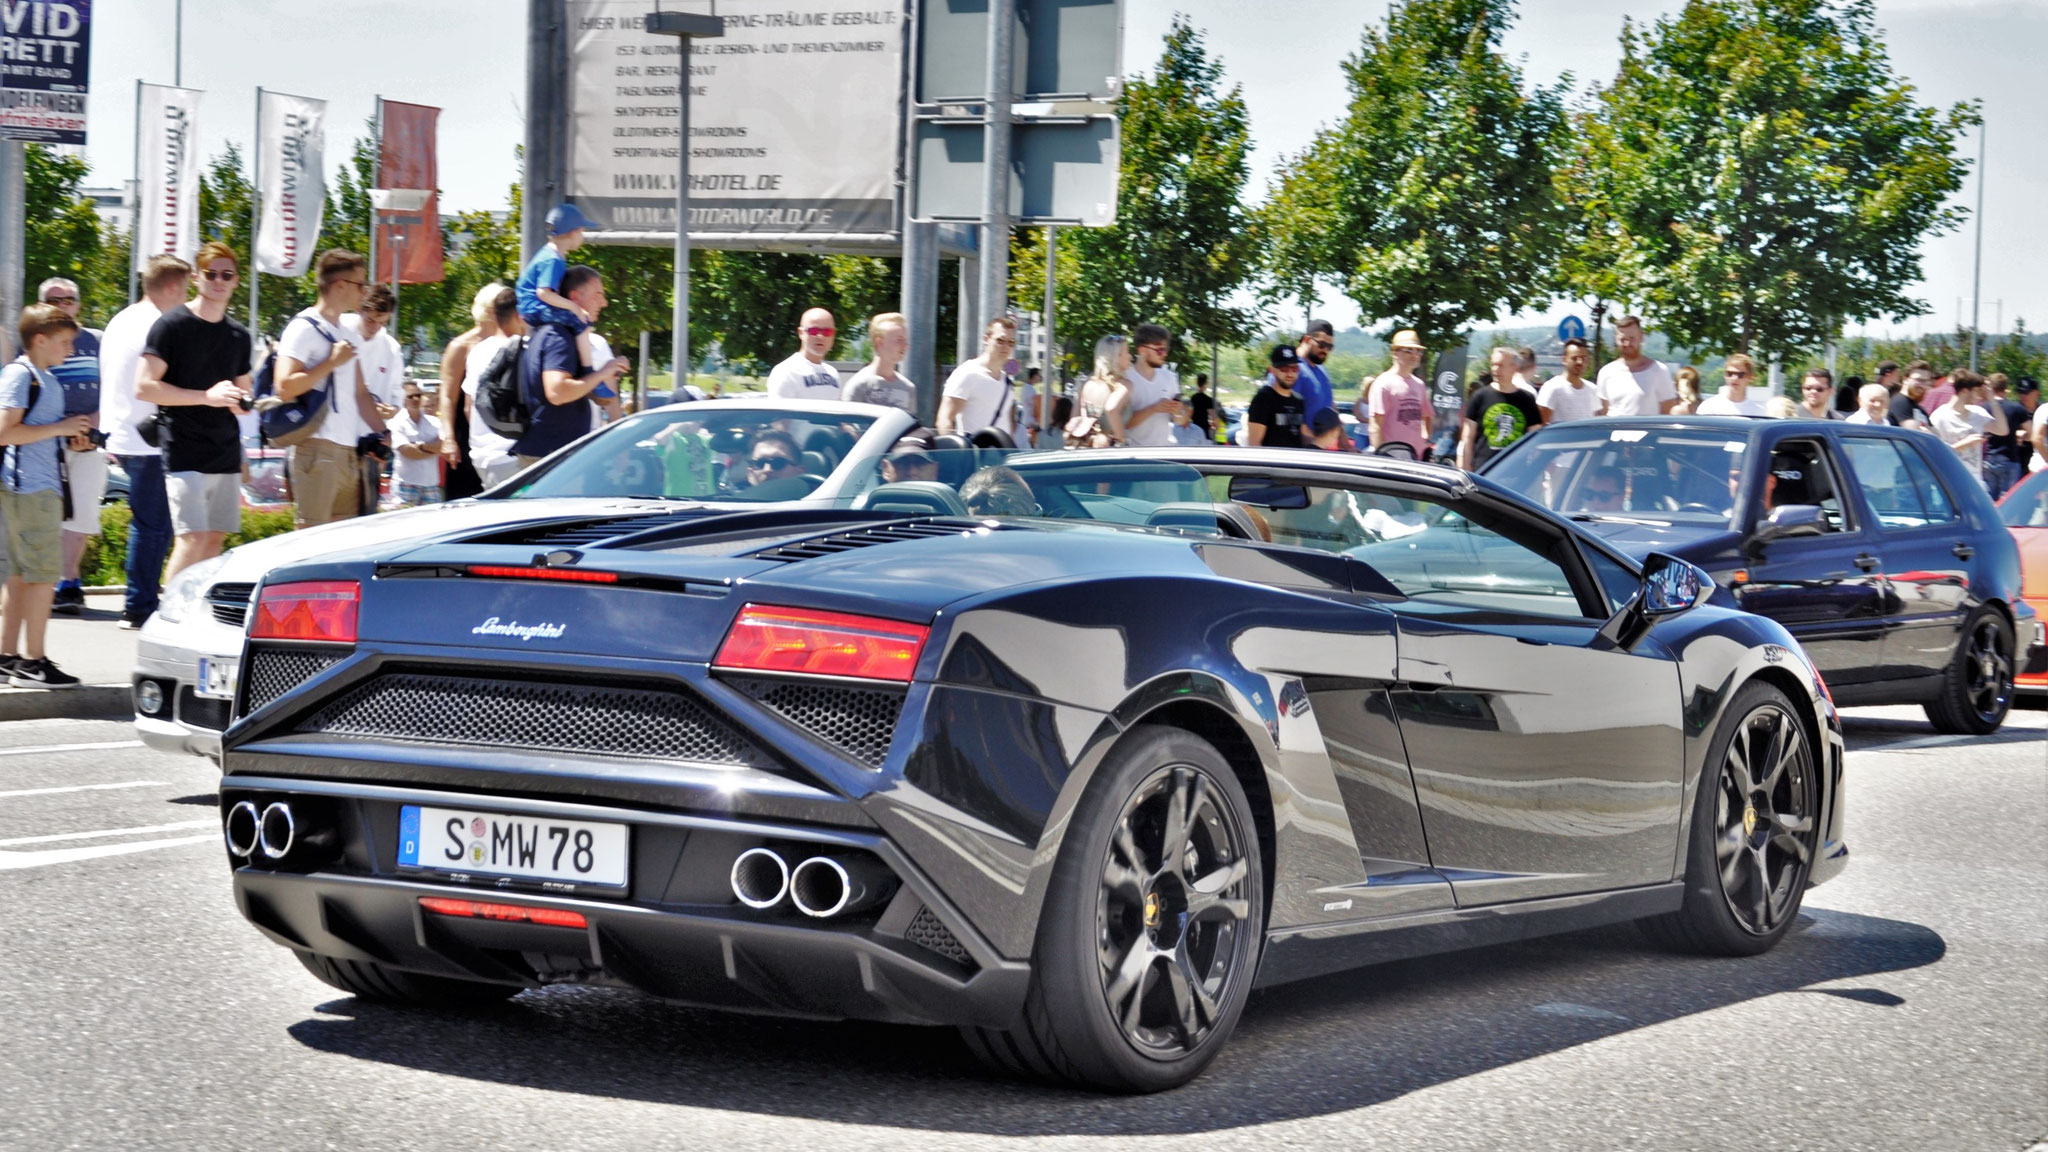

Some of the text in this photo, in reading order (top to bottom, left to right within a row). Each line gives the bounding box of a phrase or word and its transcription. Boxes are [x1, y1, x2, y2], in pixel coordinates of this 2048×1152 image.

[580, 17, 615, 30] HIER
[722, 11, 829, 28] ERNE-TRÄUME
[640, 44, 712, 55] AUTOMILE
[763, 42, 788, 54] UND
[645, 65, 717, 76] RESTARANT
[615, 85, 708, 97] TAGUNGSRÄME
[613, 126, 747, 137] OLDTIMER-SOWROOMS
[612, 147, 767, 158] SPORTWAGE-SHOWROOMS
[165, 105, 179, 252] OTORWORLD
[472, 616, 567, 641] Lamborghini
[405, 817, 594, 873] D S MW 78
